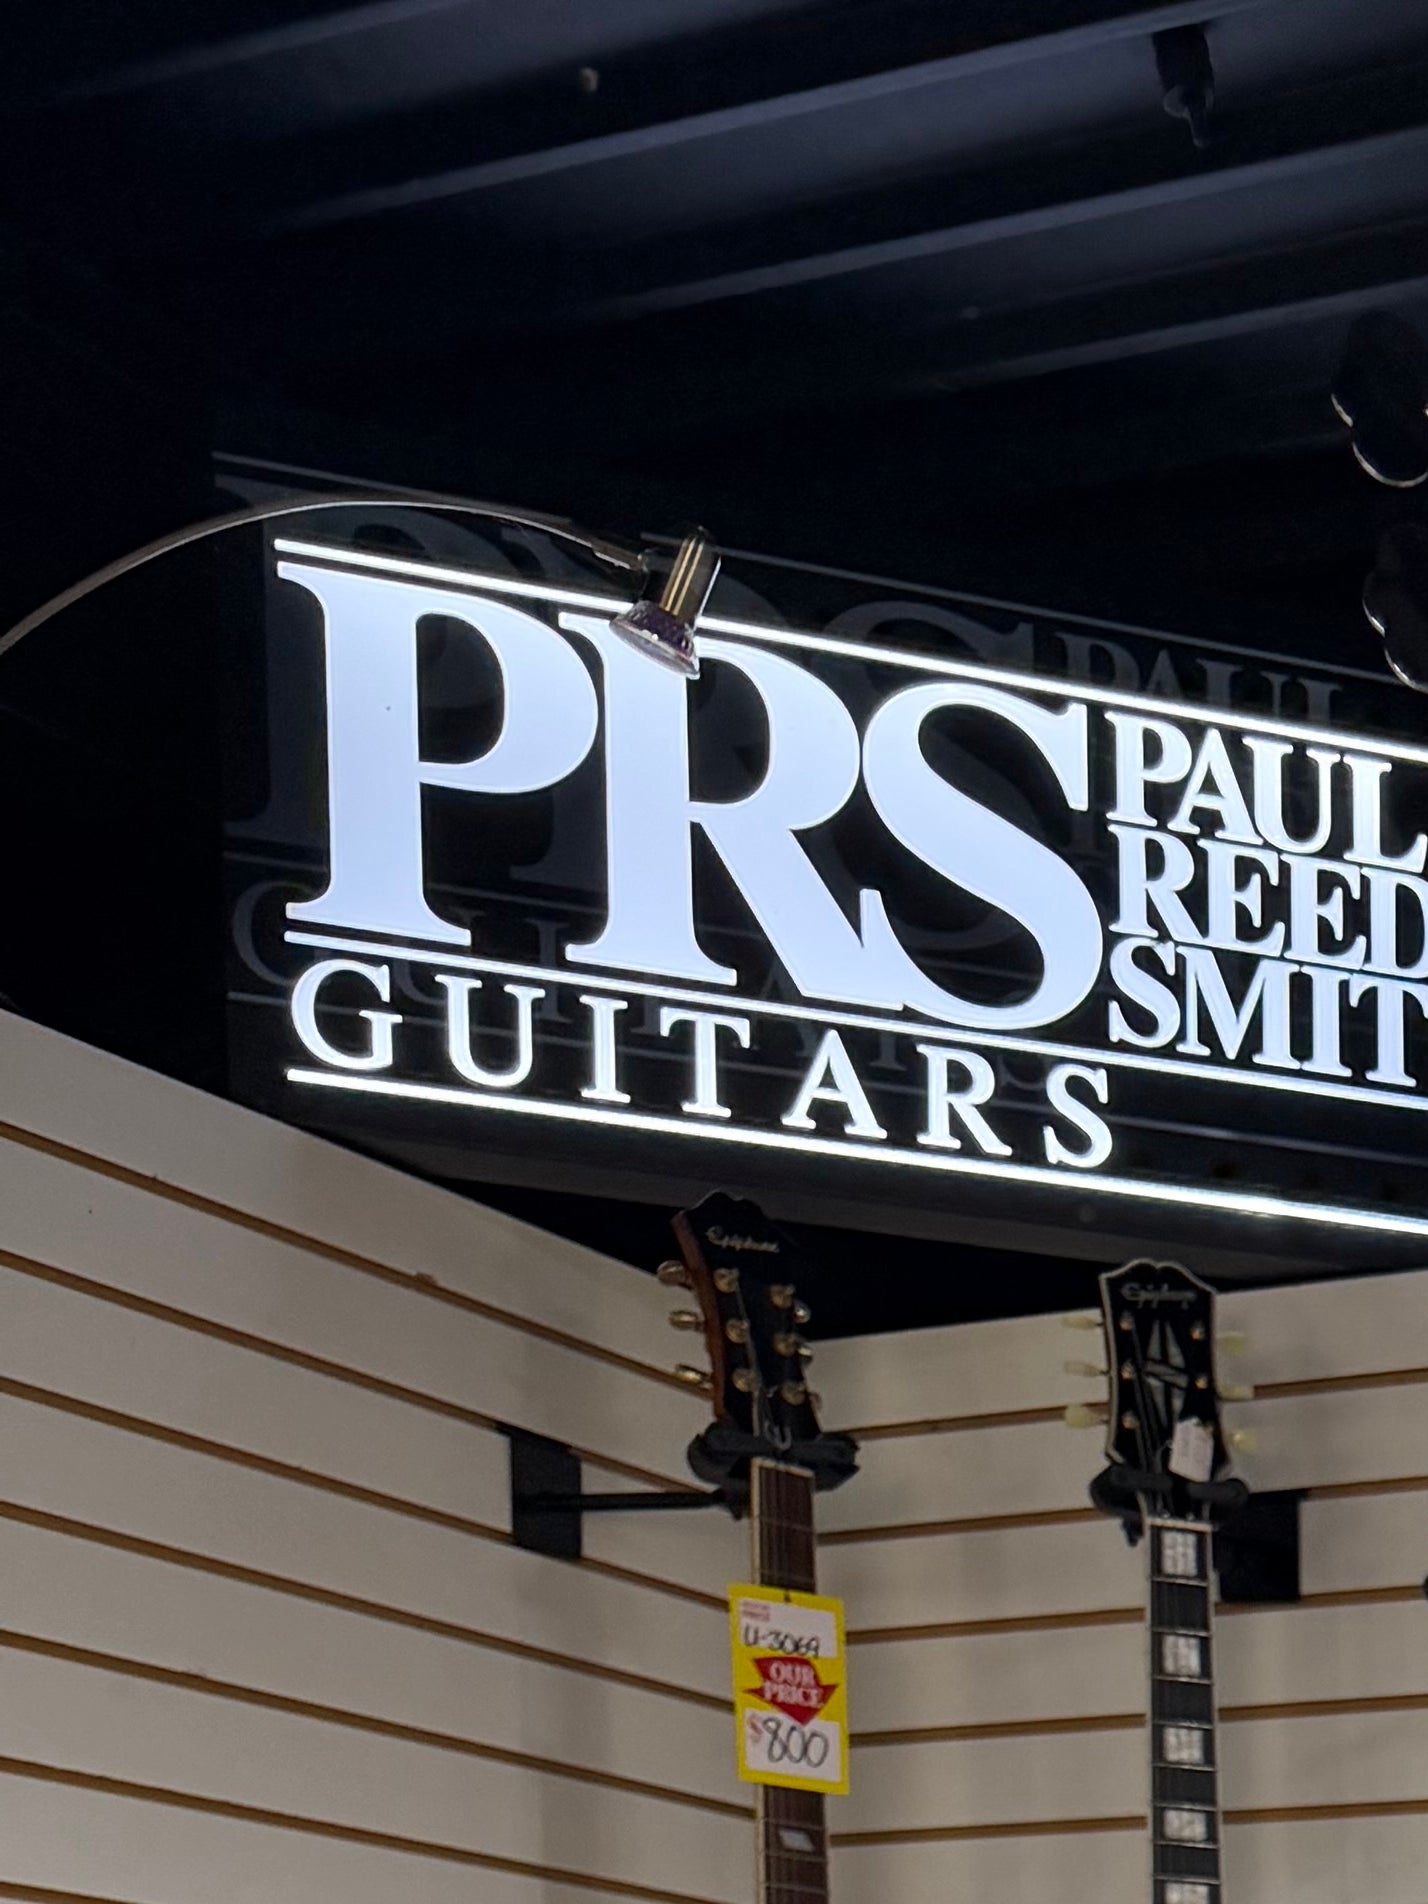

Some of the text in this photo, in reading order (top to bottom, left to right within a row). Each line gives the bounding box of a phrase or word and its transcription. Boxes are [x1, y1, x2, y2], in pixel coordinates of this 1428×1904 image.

[277, 562, 1103, 1029] PRS
[1104, 711, 1428, 873] PAUL
[290, 957, 1113, 1169] GUITARS
[763, 1682, 825, 1708] PRICE
[769, 1661, 815, 1687] OUR
[746, 1714, 829, 1768] $800
